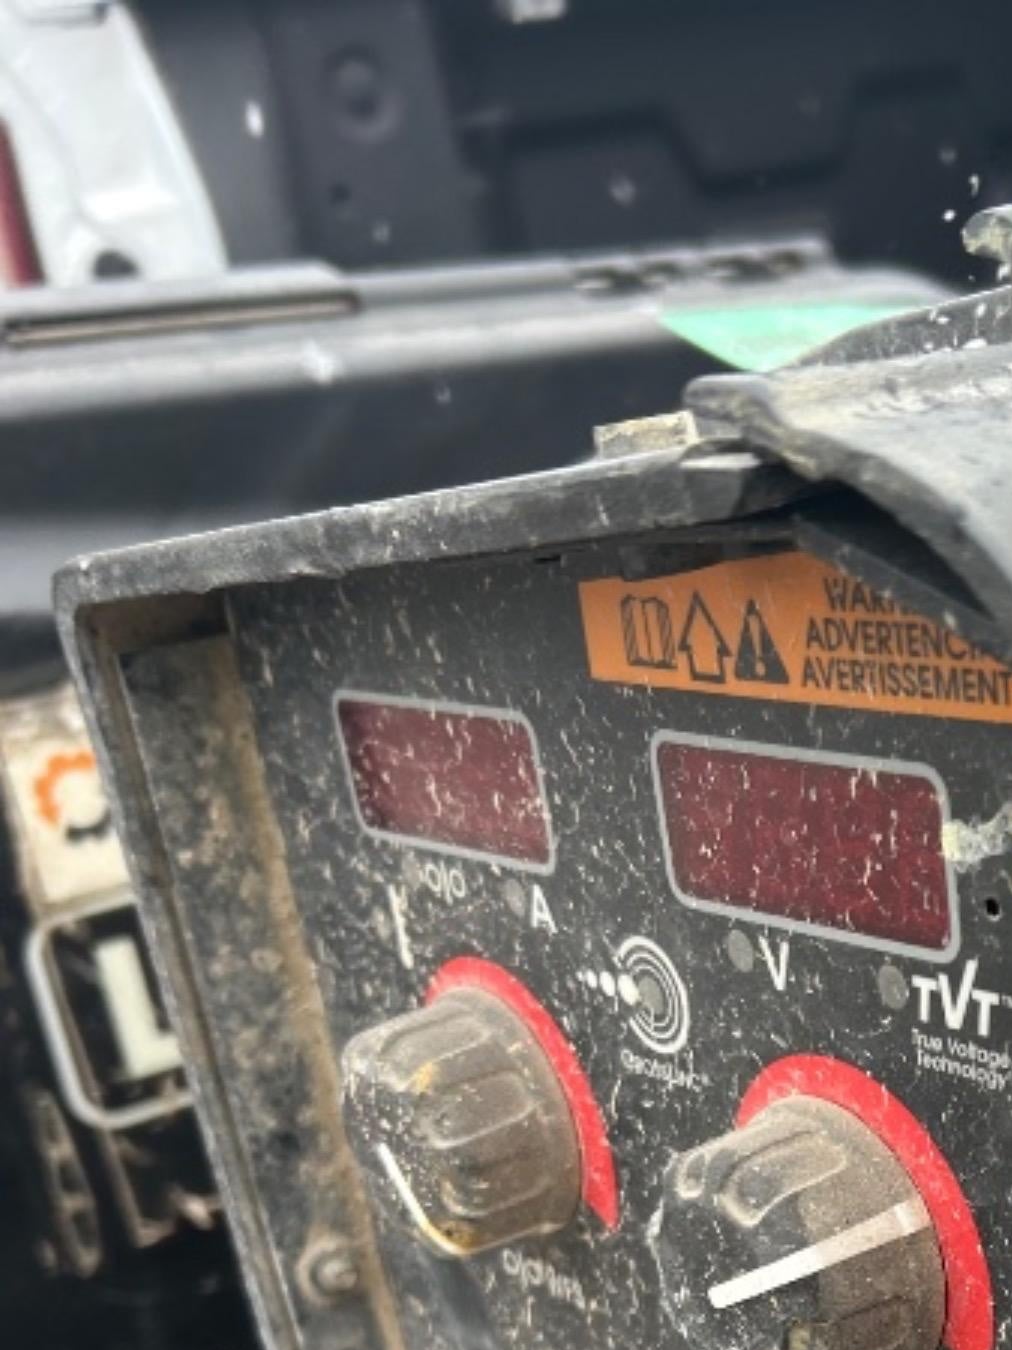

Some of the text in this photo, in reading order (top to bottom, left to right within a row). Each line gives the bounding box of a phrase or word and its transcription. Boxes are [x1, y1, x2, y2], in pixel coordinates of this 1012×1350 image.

[802, 655, 1012, 706] AVERTISSEMENT
[530, 884, 558, 934] A
[757, 935, 789, 990] V
